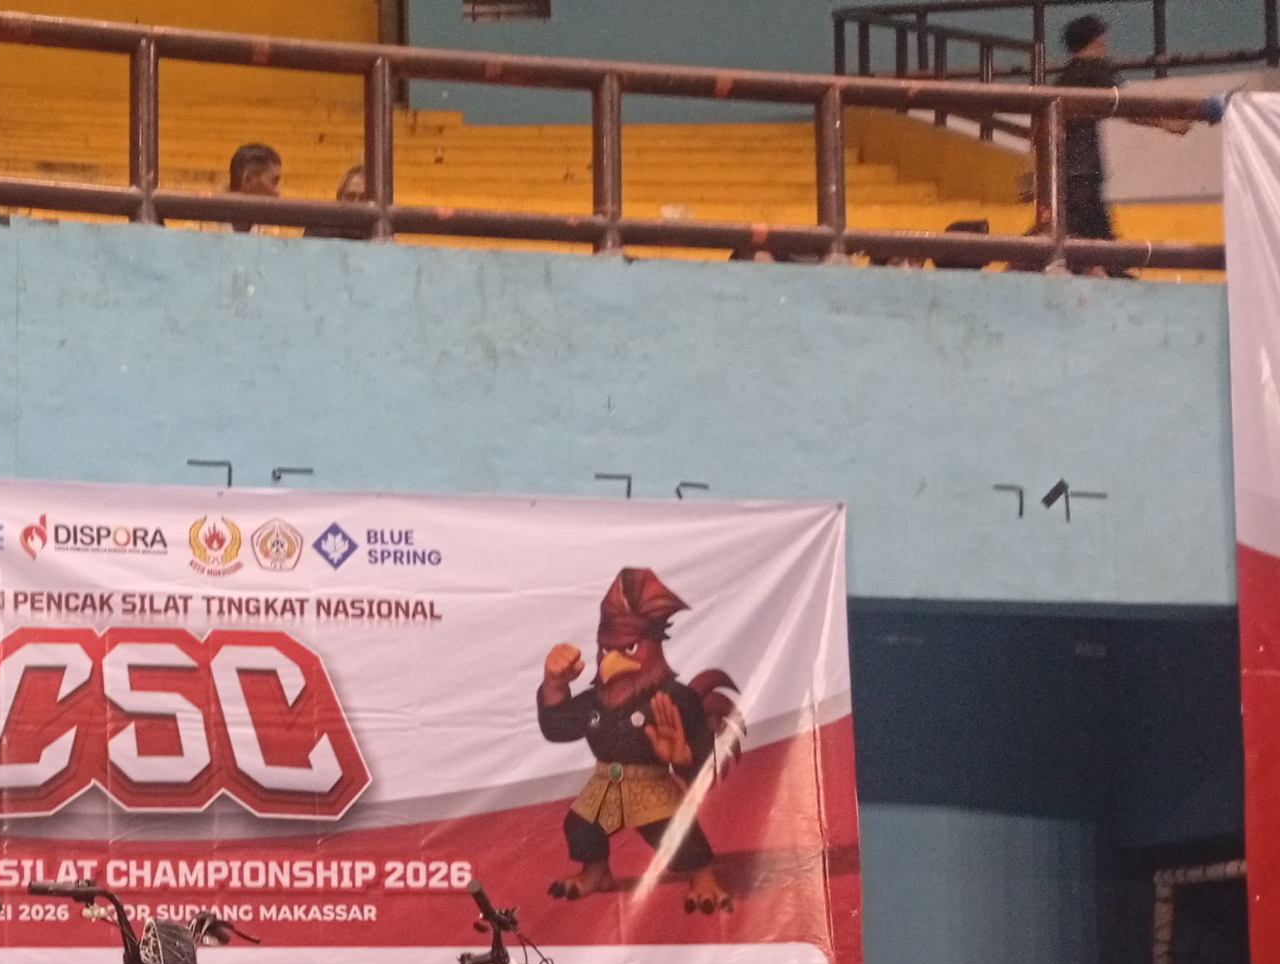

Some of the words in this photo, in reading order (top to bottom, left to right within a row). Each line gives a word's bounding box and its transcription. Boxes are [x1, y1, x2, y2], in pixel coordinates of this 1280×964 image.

[53, 523, 168, 548] DISPORA
[366, 528, 414, 546] BLUE
[367, 549, 442, 567] SPRING
[13, 591, 115, 614] PENCAK
[121, 594, 193, 615] SILAT
[201, 595, 309, 617] TINGKAT
[316, 598, 443, 620] NASIONAL
[106, 859, 377, 889] CHAMPIONSHIP
[384, 861, 473, 889] 2026
[18, 904, 69, 921] 2026
[259, 904, 378, 922] MAKASSAR
